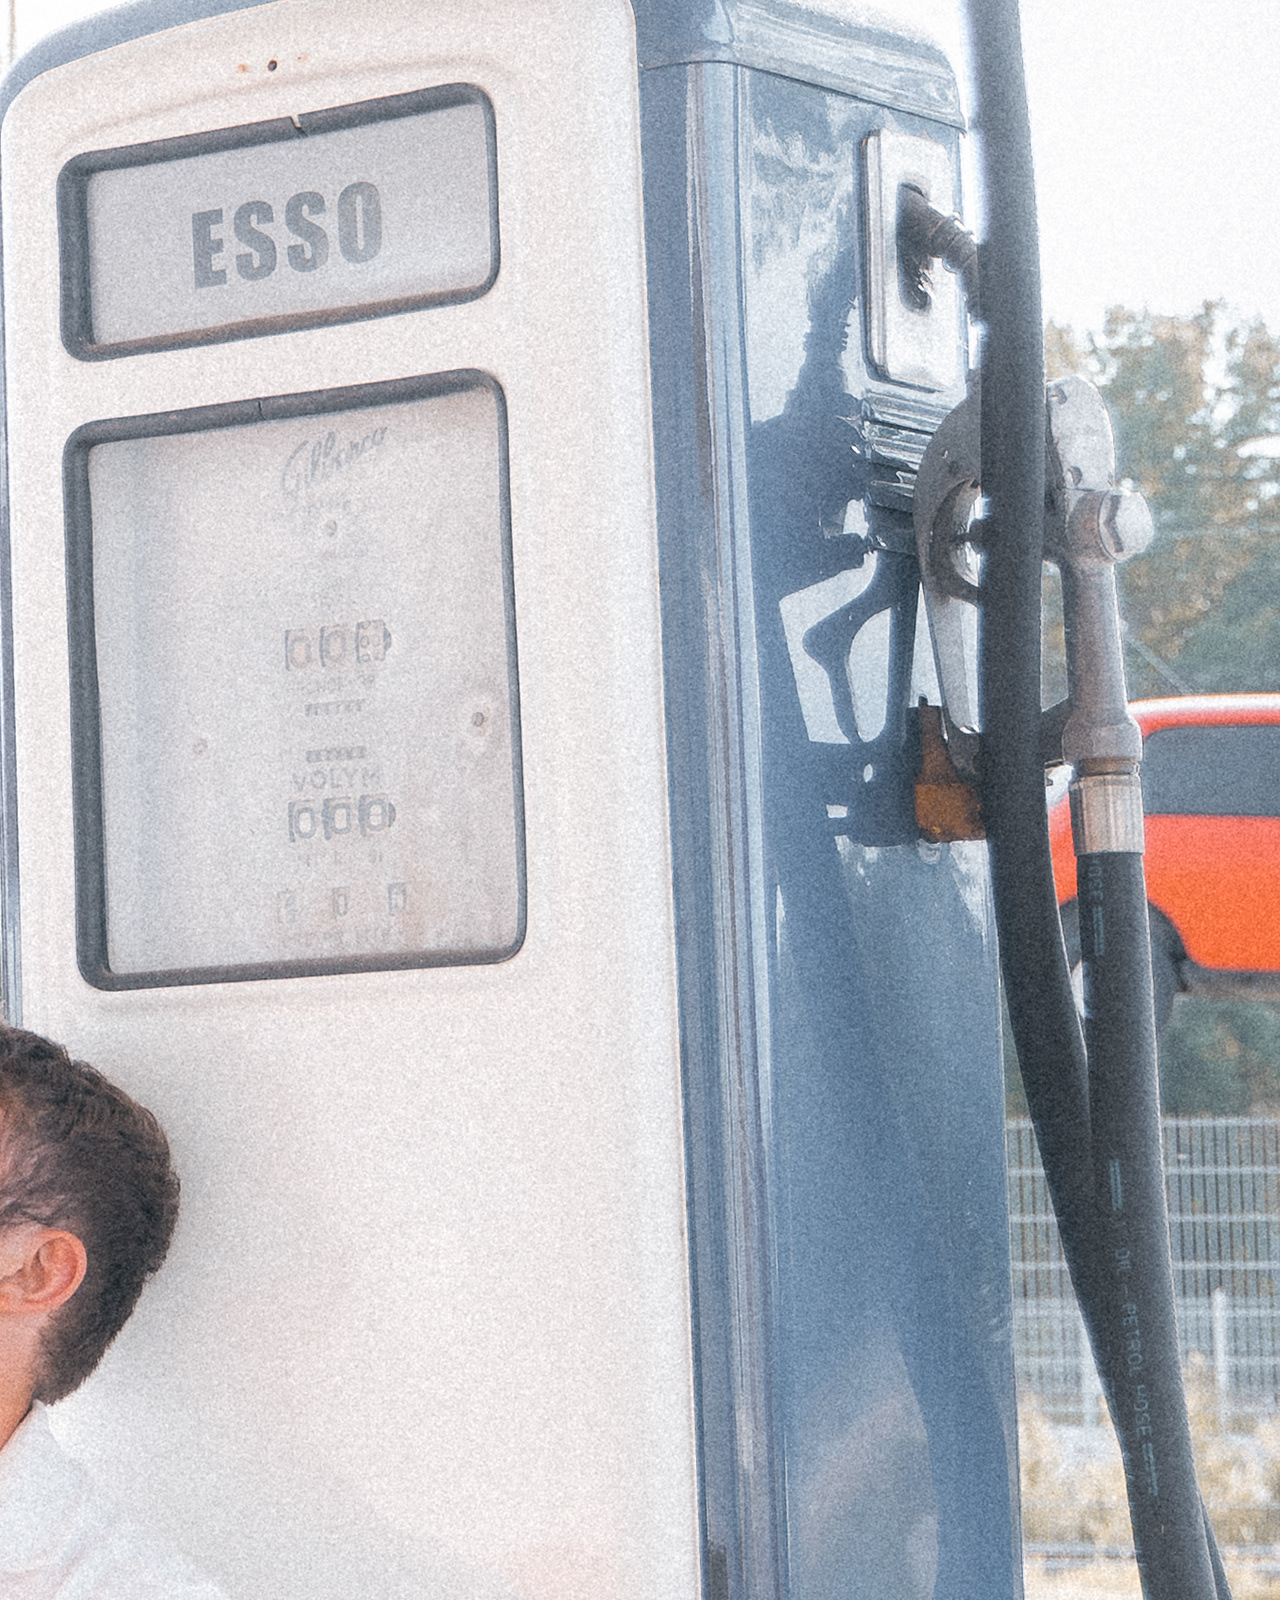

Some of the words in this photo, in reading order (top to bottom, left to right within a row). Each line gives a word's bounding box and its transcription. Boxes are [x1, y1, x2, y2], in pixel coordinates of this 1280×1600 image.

[192, 181, 382, 289] ESSO
[292, 766, 382, 791] VOLYM
[1121, 1302, 1143, 1377] PETROL
